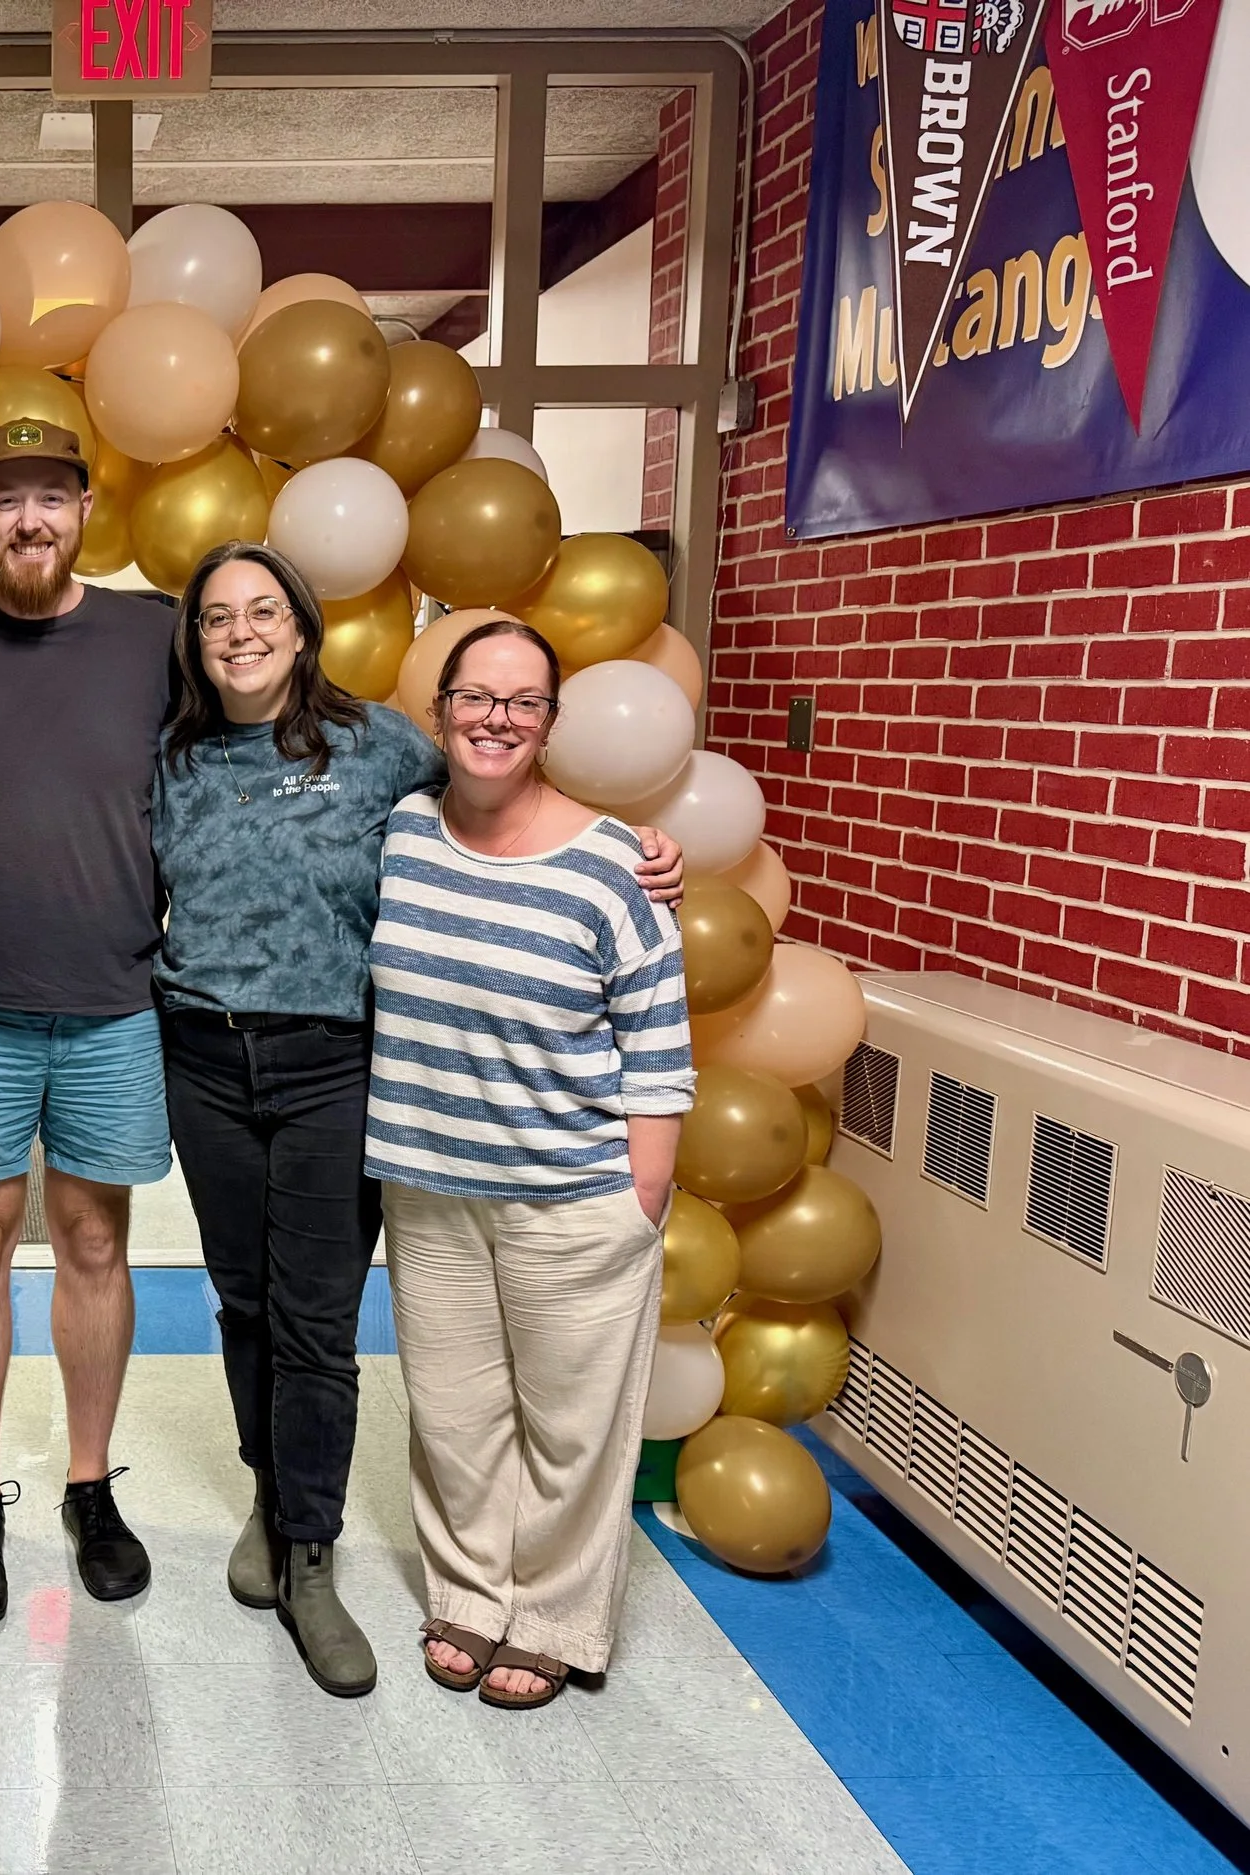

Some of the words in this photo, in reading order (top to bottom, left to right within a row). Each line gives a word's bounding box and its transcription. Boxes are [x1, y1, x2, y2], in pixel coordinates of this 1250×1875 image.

[81, 0, 190, 80] EXIT
[904, 58, 972, 267] BROWN
[1105, 67, 1154, 288] Stanford
[833, 231, 1103, 402] Muang
[273, 787, 283, 797] to
[285, 785, 302, 795] the
[304, 782, 341, 794] People
[282, 775, 297, 786] All
